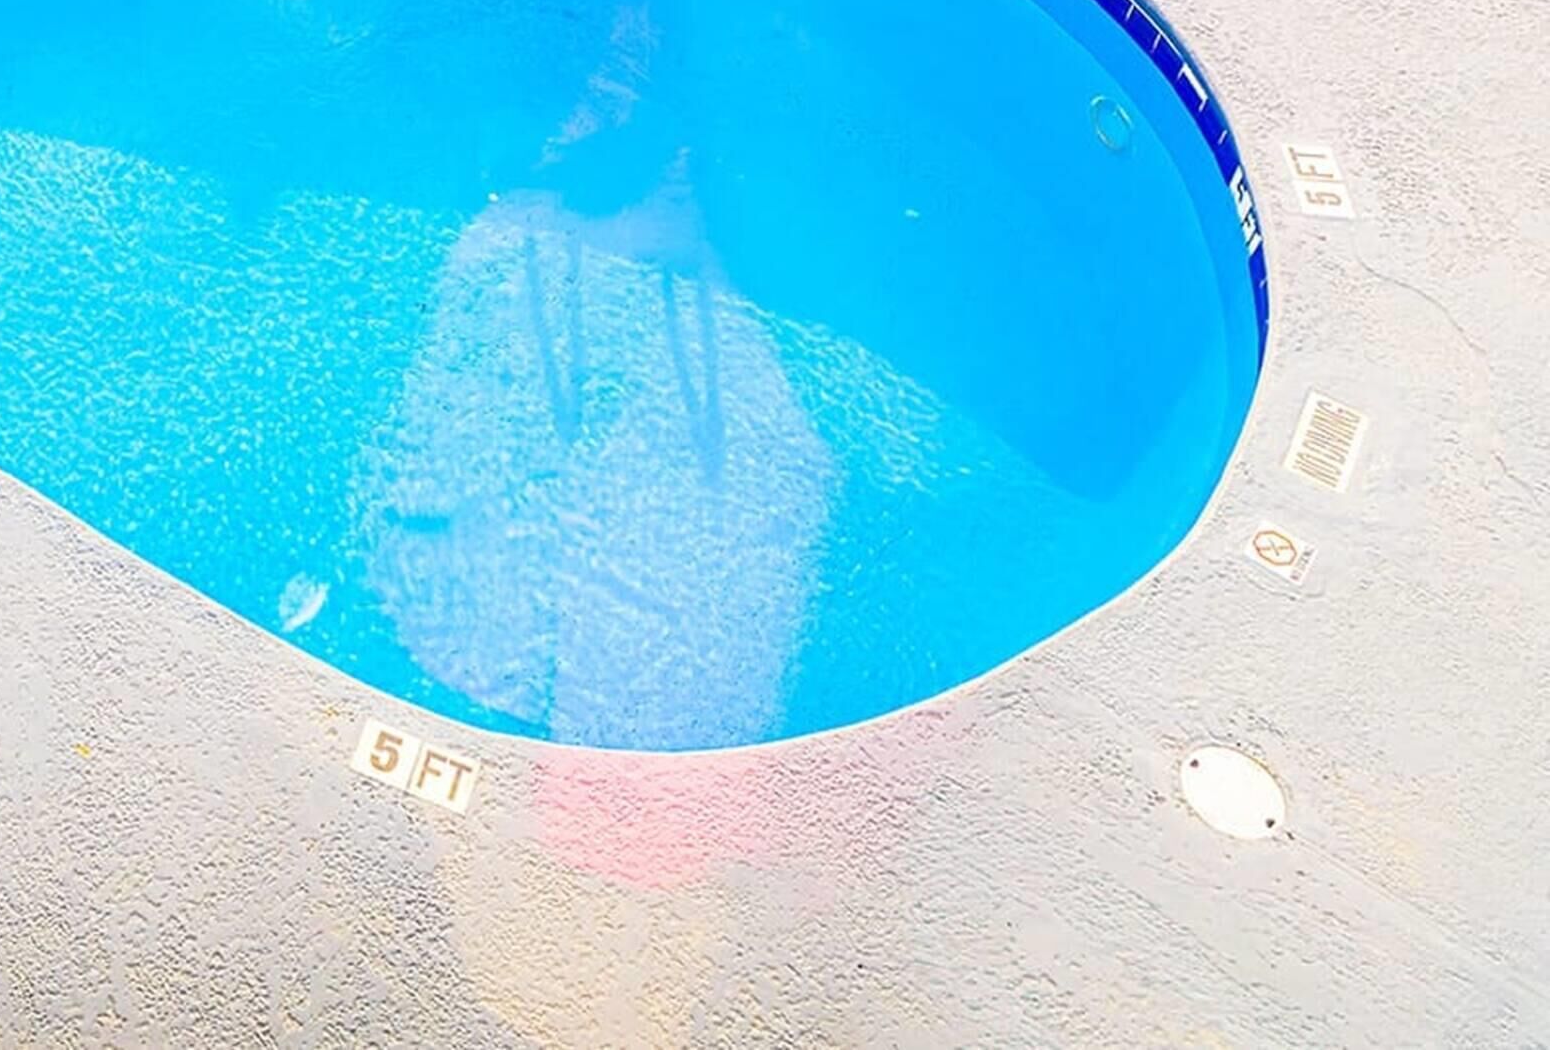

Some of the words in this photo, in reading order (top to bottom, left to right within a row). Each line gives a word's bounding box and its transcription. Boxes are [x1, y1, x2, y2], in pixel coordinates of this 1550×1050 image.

[1288, 147, 1334, 179] FT
[1305, 190, 1342, 206] 5
[1239, 207, 1262, 247] FT
[1302, 401, 1361, 465] DIVING
[1292, 452, 1342, 488] NO
[369, 730, 403, 773] 5
[417, 749, 473, 801] FT
